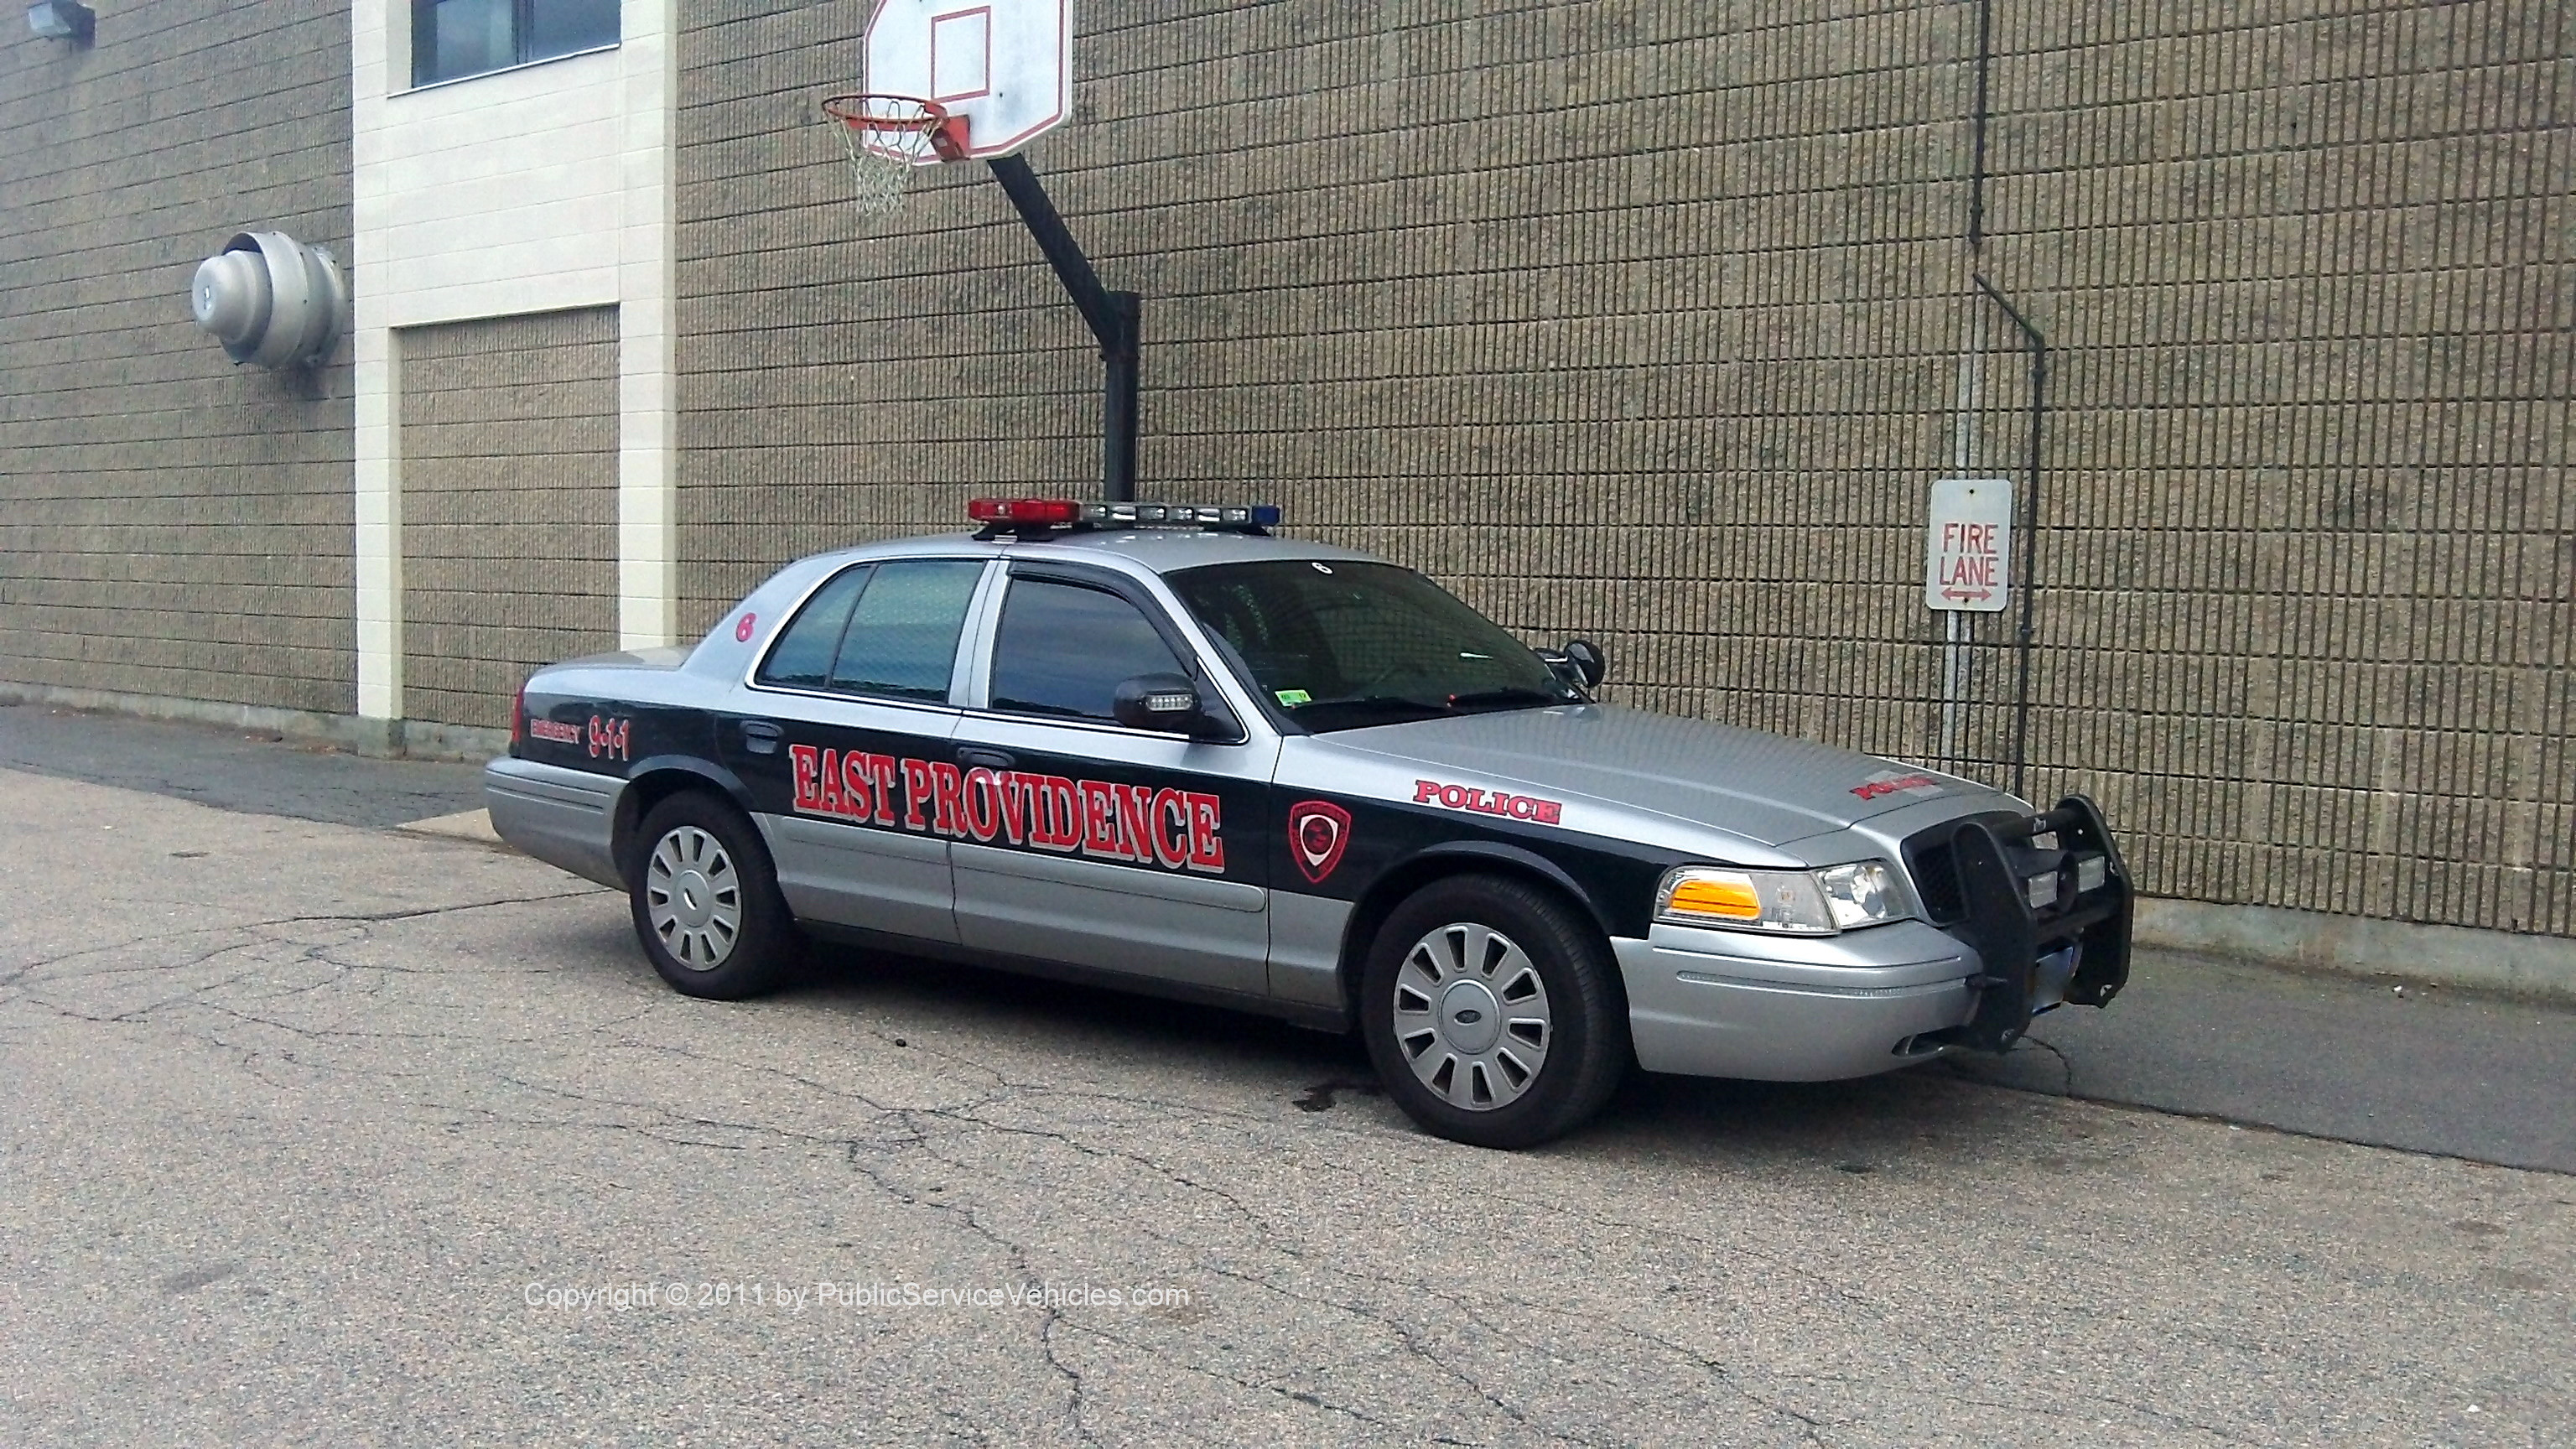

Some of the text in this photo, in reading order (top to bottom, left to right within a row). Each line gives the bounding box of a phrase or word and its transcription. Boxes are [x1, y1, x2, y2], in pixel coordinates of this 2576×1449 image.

[1943, 523, 1998, 554] FIRE
[1311, 562, 1333, 574] 6
[1939, 556, 1999, 586] LANE
[735, 612, 757, 642] 6
[589, 714, 630, 761] 9-1-1
[789, 744, 896, 828] EAST
[900, 757, 1226, 874] PROVIDENCE
[1413, 779, 1562, 825] POLICE
